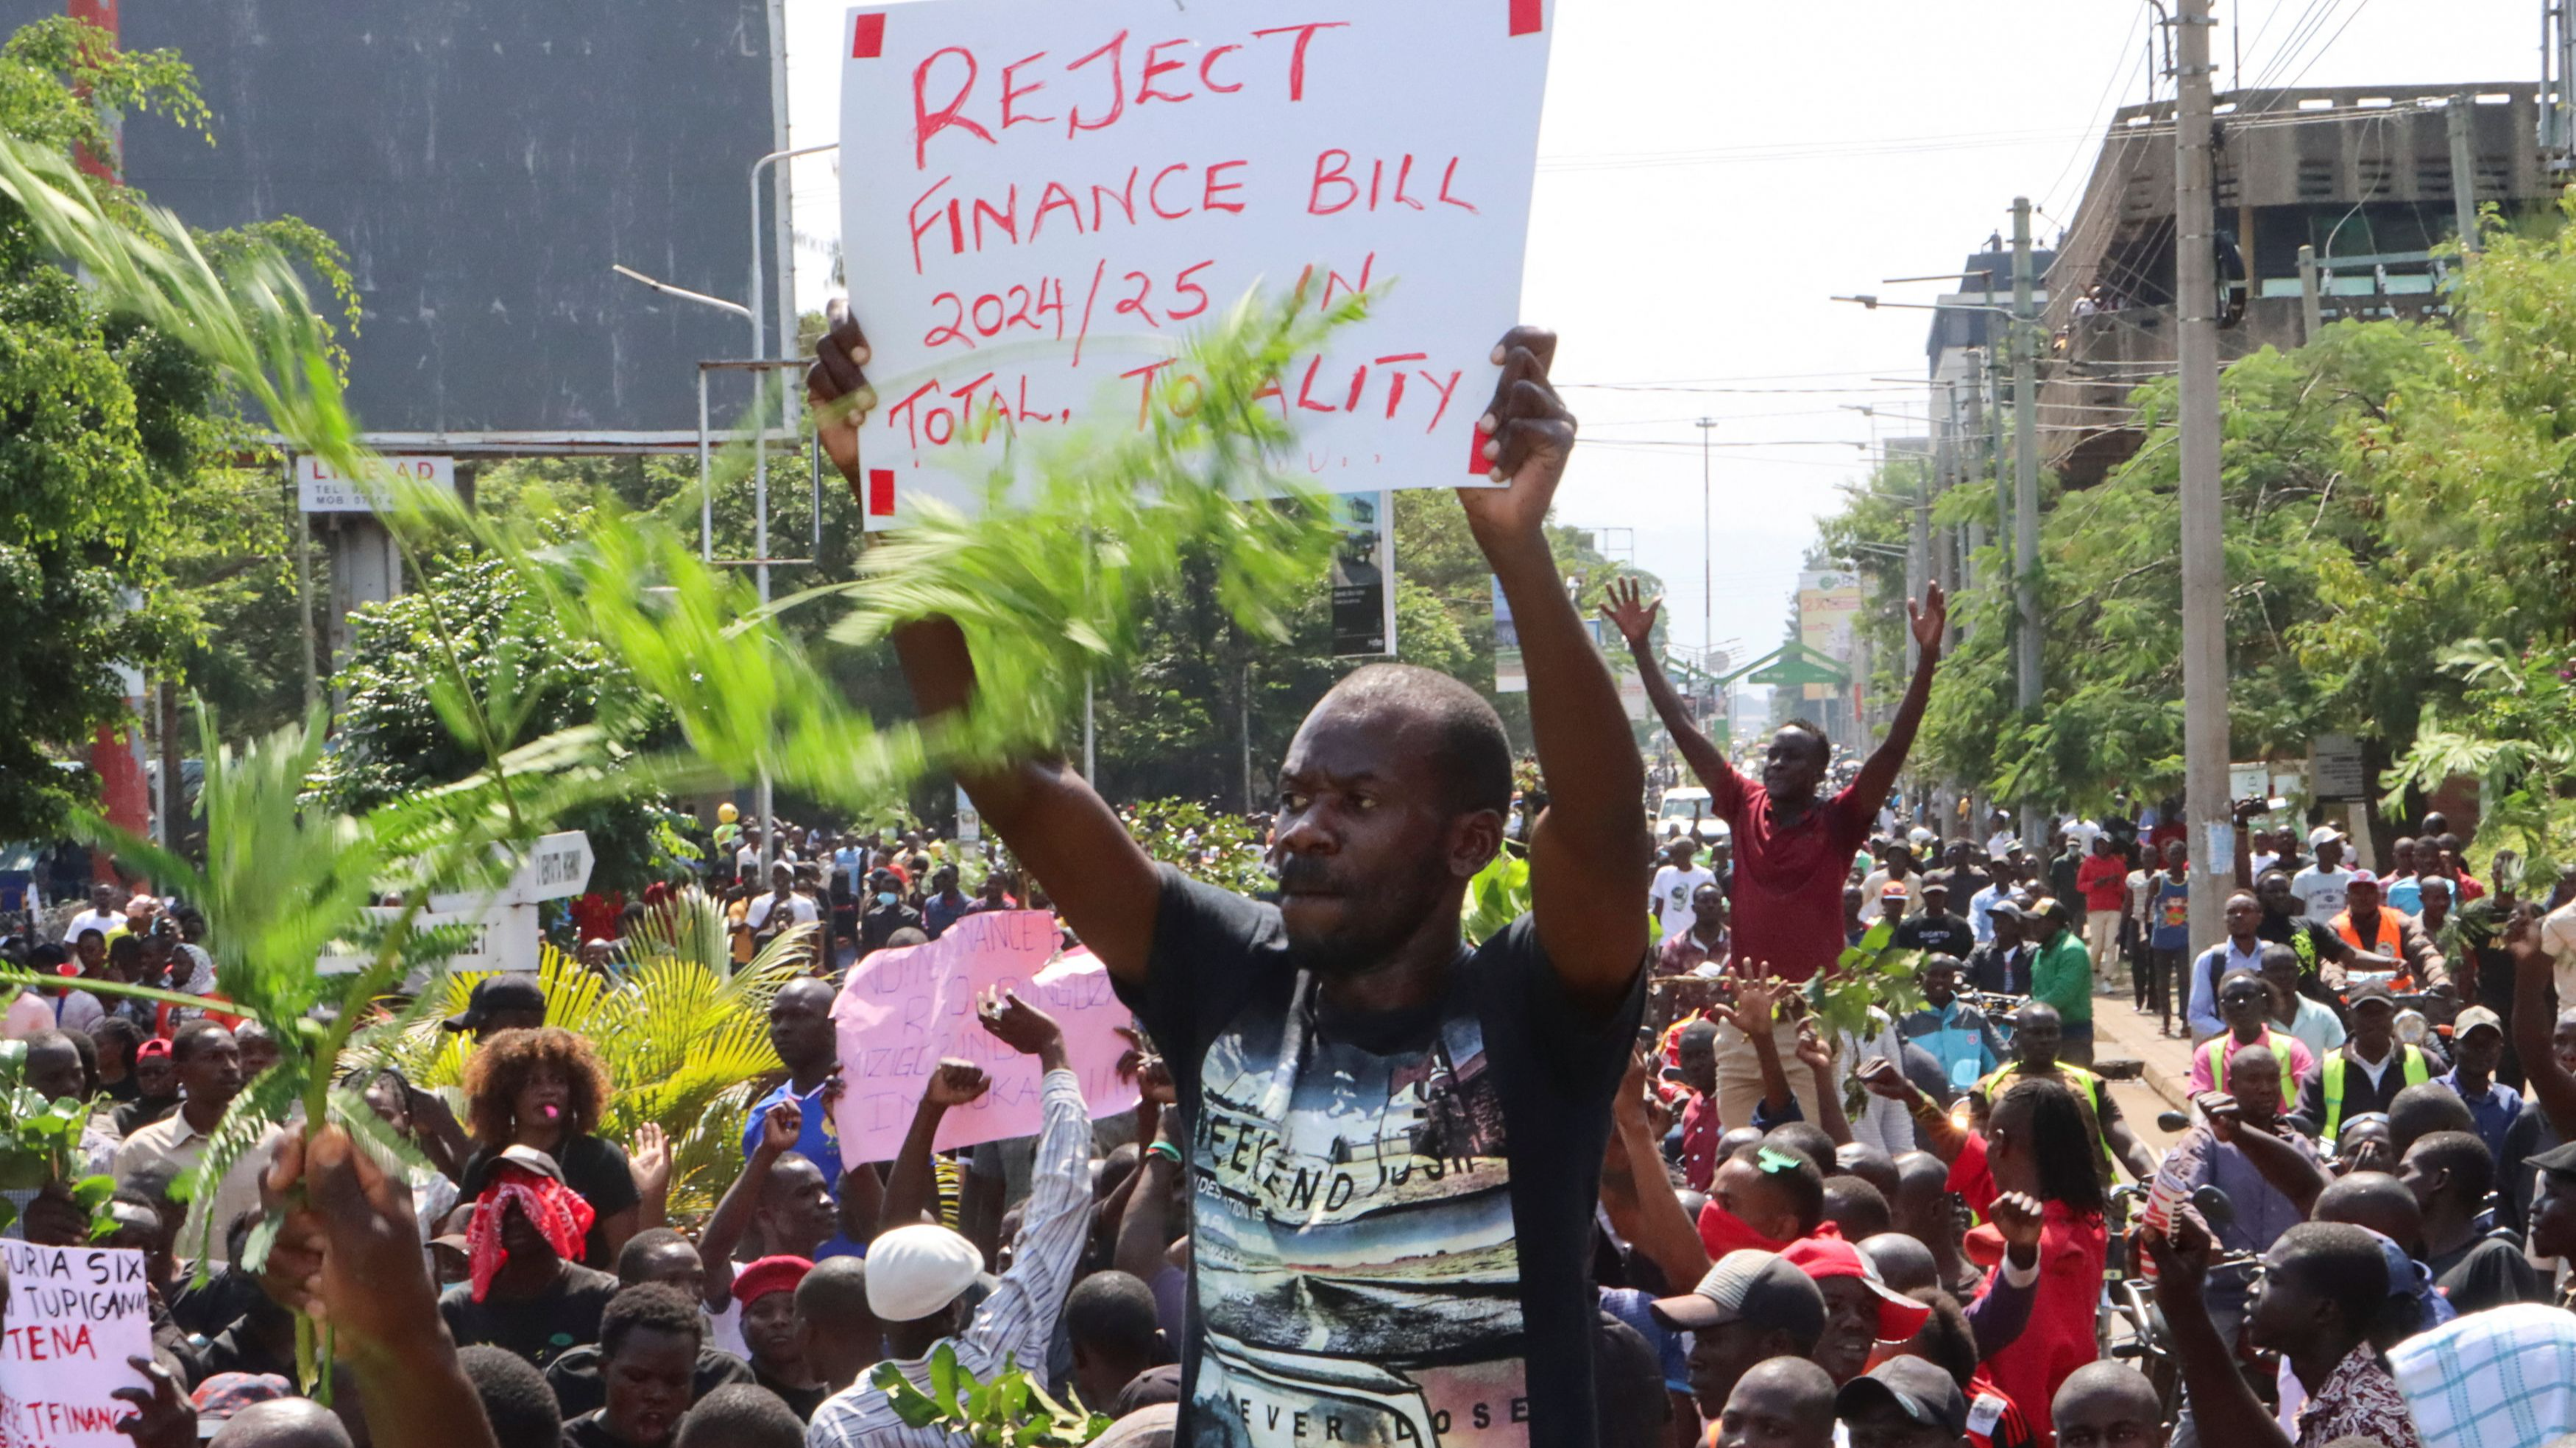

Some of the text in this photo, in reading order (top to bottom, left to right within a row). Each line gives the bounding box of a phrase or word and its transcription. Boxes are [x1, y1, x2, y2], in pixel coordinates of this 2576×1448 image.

[913, 21, 1351, 170] REJECT
[907, 148, 1480, 274] FINANCE BILL
[924, 251, 1376, 367] 2024/25 IN
[1119, 352, 1462, 435] TOALITY
[0, 1245, 143, 1285] URIA SIX
[6, 1324, 96, 1360] TENA
[1240, 1398, 1342, 1441] EVER
